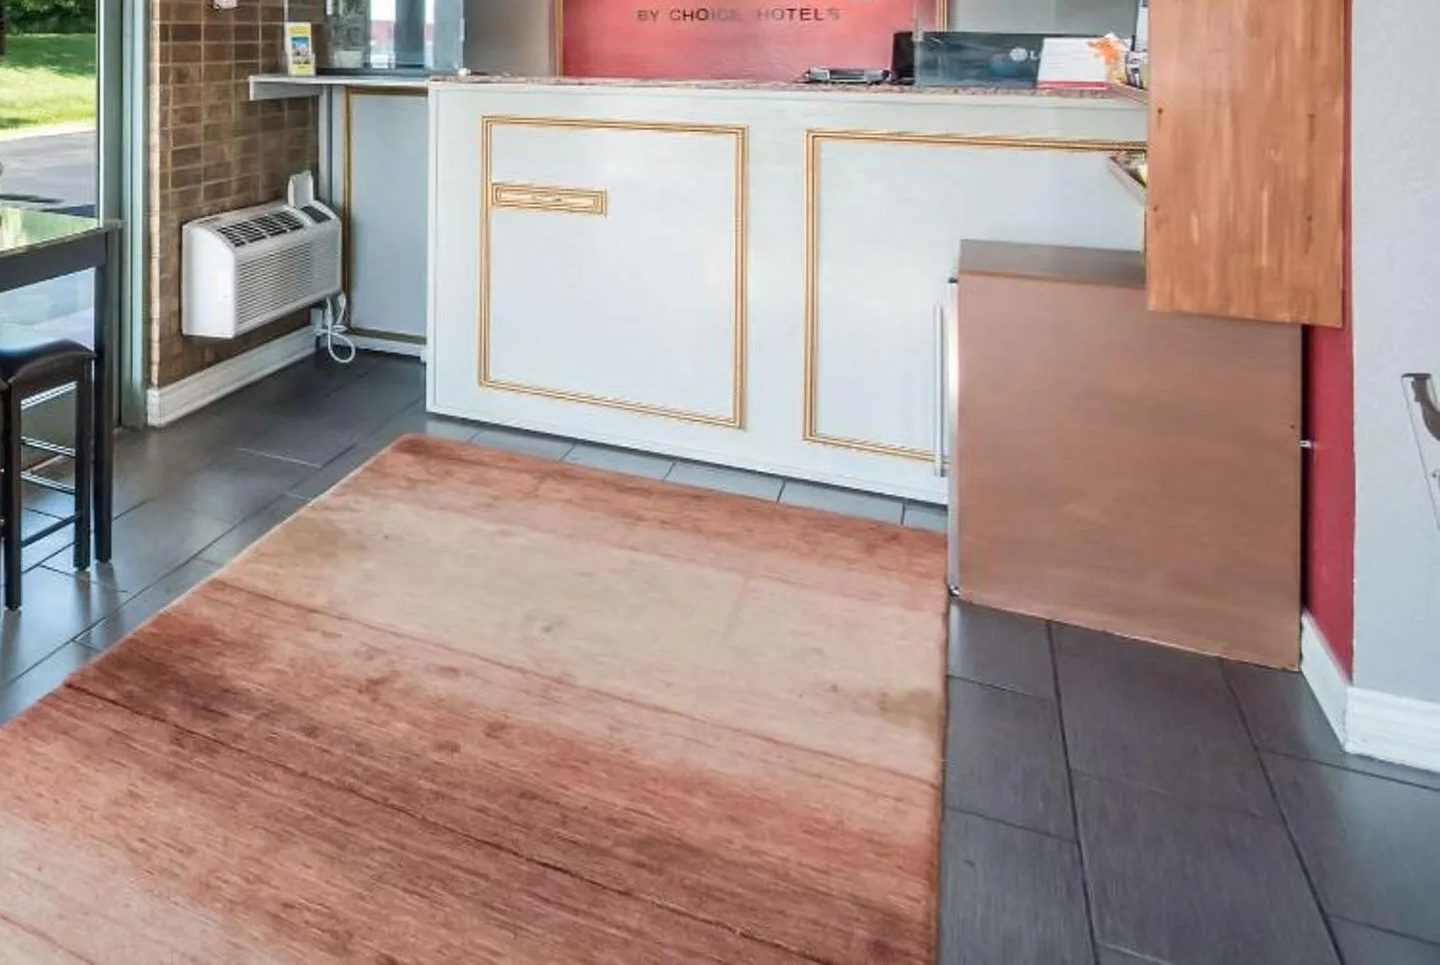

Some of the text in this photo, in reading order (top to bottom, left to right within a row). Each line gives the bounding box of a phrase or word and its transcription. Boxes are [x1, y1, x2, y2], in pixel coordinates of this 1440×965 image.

[636, 7, 841, 23] BY CHOICE HOTELS
